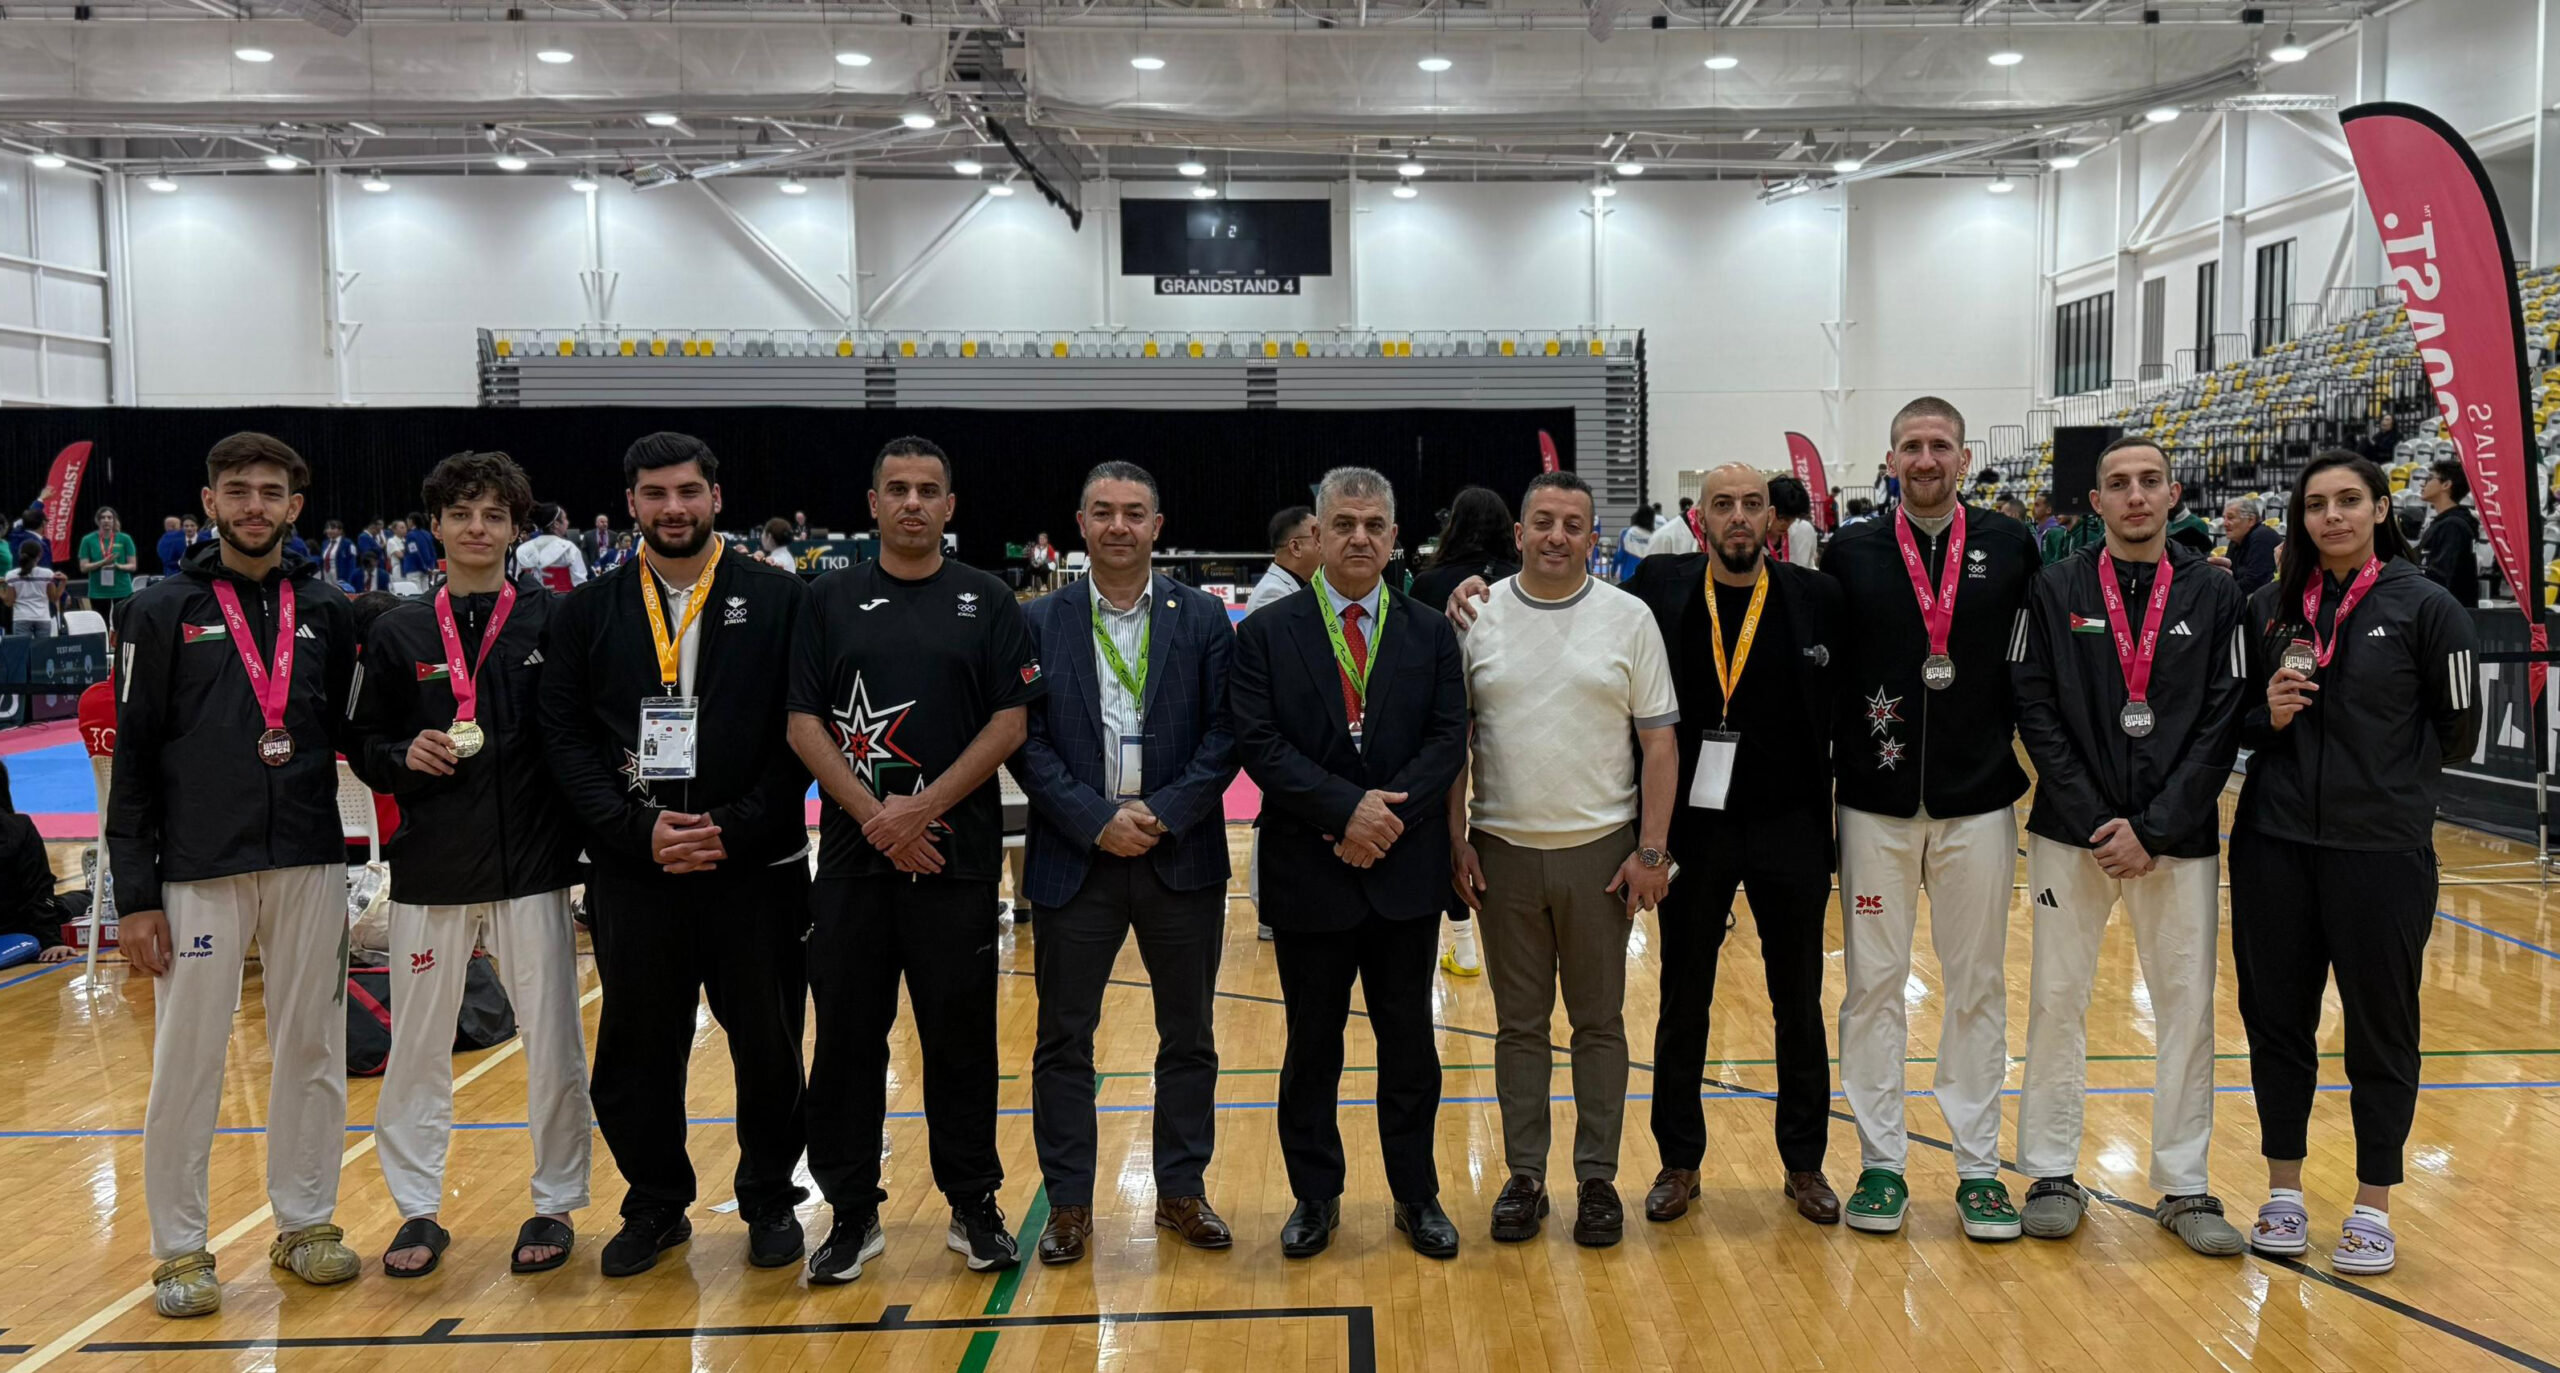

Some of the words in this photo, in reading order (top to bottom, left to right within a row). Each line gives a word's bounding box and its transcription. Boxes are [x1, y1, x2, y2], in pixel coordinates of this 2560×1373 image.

[1160, 278, 1280, 294] GRANDSTAND
[1283, 279, 1295, 292] 4
[55, 460, 81, 541] GOLDCOAST.
[644, 583, 658, 611] COACH
[723, 617, 747, 626] JORDAN
[1327, 622, 1339, 635] VIP
[1741, 615, 1757, 643] COACH
[2284, 661, 2313, 671] OPEN
[2124, 719, 2151, 728] OPEN
[263, 747, 291, 756] OPEN
[179, 950, 213, 958] KPNP
